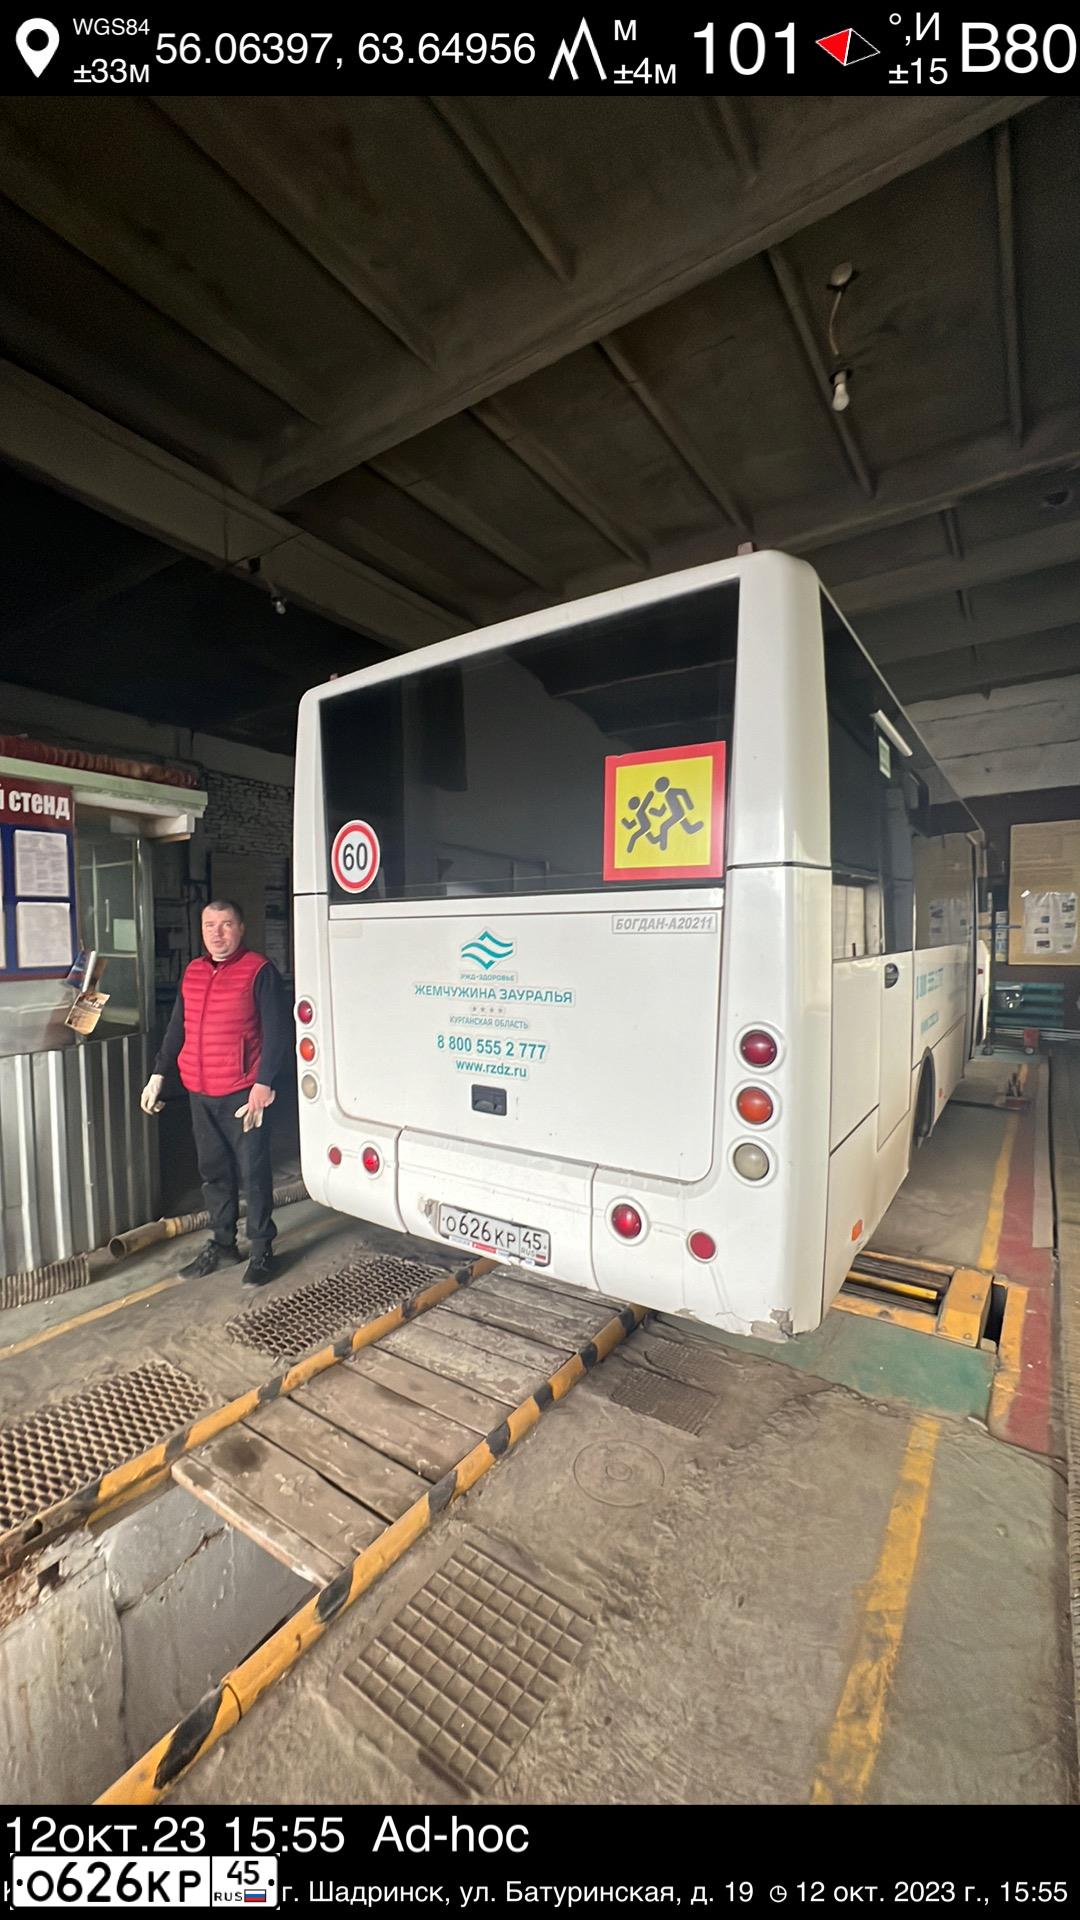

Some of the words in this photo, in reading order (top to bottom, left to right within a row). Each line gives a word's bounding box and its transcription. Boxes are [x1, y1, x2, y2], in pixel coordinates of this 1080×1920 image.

[343, 842, 368, 871] 60
[415, 985, 496, 999] ЖЕМЧУЖИНА
[499, 988, 573, 1003] ЗАУРАЛЬЯ
[449, 1015, 493, 1027] КУРГАНСКАЯ
[494, 1019, 529, 1030] ОБЛАСТЬ
[437, 1034, 445, 1049] 8
[448, 1035, 472, 1052] 800
[476, 1038, 501, 1055] 555
[505, 1041, 515, 1057] 2
[518, 1042, 546, 1060] 777
[455, 1060, 528, 1078] www.rzdz.ru
[522, 1231, 542, 1250] 45
